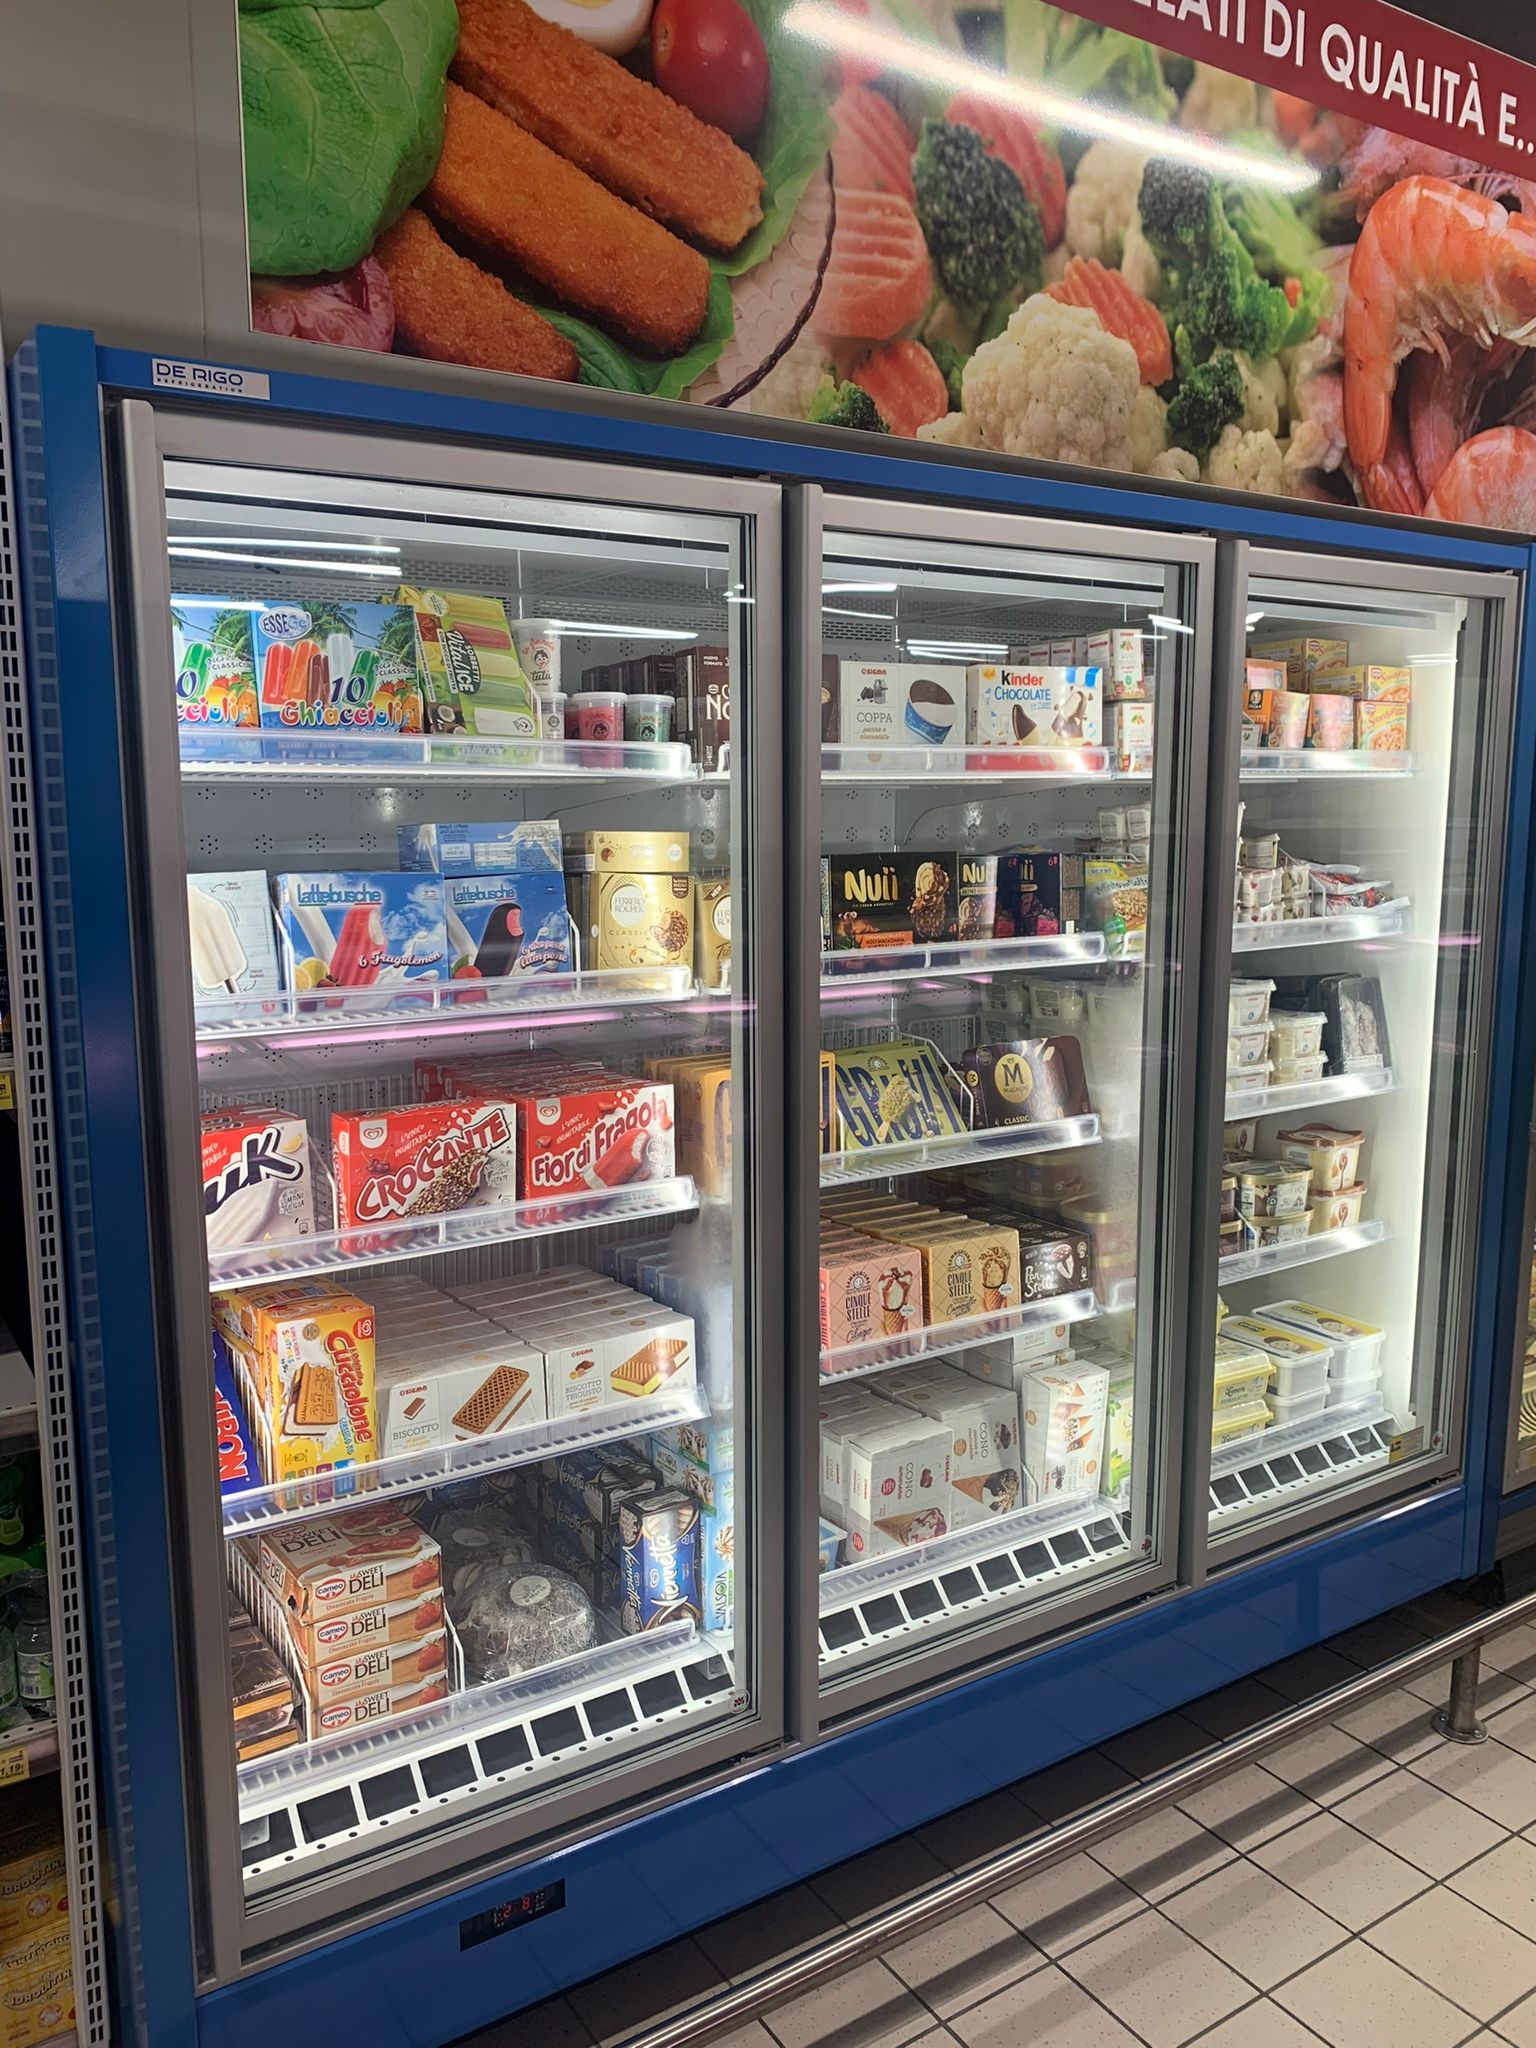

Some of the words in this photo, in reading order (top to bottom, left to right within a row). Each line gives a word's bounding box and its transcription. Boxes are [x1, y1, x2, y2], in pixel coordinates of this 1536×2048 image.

[1264, 0, 1306, 67] DI
[1320, 23, 1485, 136] QUALITÀ
[156, 362, 186, 379] DE
[193, 367, 244, 386] RIGO
[157, 377, 244, 394] REFRIGERATION
[465, 645, 481, 682] SORBETTI
[1001, 670, 1044, 686] Kinder
[331, 675, 366, 704] 10
[994, 686, 1051, 701] CHOCOLATE
[280, 700, 403, 727] Ghiaccioli
[857, 712, 893, 724] COPPA
[844, 866, 899, 903] Nuii
[614, 897, 644, 905] FERRERO
[614, 904, 645, 913] ROCHER
[359, 957, 367, 968] 6
[1004, 1115, 1030, 1125] CLASSIC
[357, 1111, 507, 1218] CROCCANTE
[534, 1150, 575, 1183] Fior
[576, 1139, 591, 1169] di
[947, 1270, 972, 1286] CINQUE
[948, 1284, 971, 1298] STELLE
[845, 1292, 871, 1310] CINQUE
[846, 1305, 871, 1321] STELLE
[325, 1330, 373, 1442] Cucciolone
[565, 1380, 602, 1394] BISCOTTO
[565, 1387, 602, 1401] TRIGUSTO
[392, 1423, 440, 1440] BISCOTTO
[979, 1422, 988, 1459] CONO
[904, 1462, 914, 1499] CONO
[281, 1531, 341, 1553] DELI
[358, 1565, 384, 1577] SWEET
[622, 1545, 642, 1612] Viennetta
[649, 1532, 689, 1622] Viennetta
[317, 1583, 344, 1595] cameo
[349, 1572, 384, 1594] DELI
[326, 1598, 355, 1610] Cheesecake
[355, 1594, 374, 1605] Fragola
[714, 1571, 728, 1620] VALSOIA
[359, 1607, 386, 1621] SWEET
[319, 1625, 346, 1638] cameo
[351, 1613, 386, 1636] DELI
[328, 1641, 357, 1654] Cheesecake
[358, 1636, 377, 1647] Fragola
[363, 1650, 389, 1663] SWEET
[323, 1667, 349, 1681] cameo
[355, 1656, 389, 1679] DELI
[332, 1684, 360, 1697] Cheesecake
[361, 1678, 379, 1688] Fragola
[363, 1691, 389, 1704] SWEET
[323, 1710, 349, 1723] cameo
[355, 1698, 390, 1721] DELI
